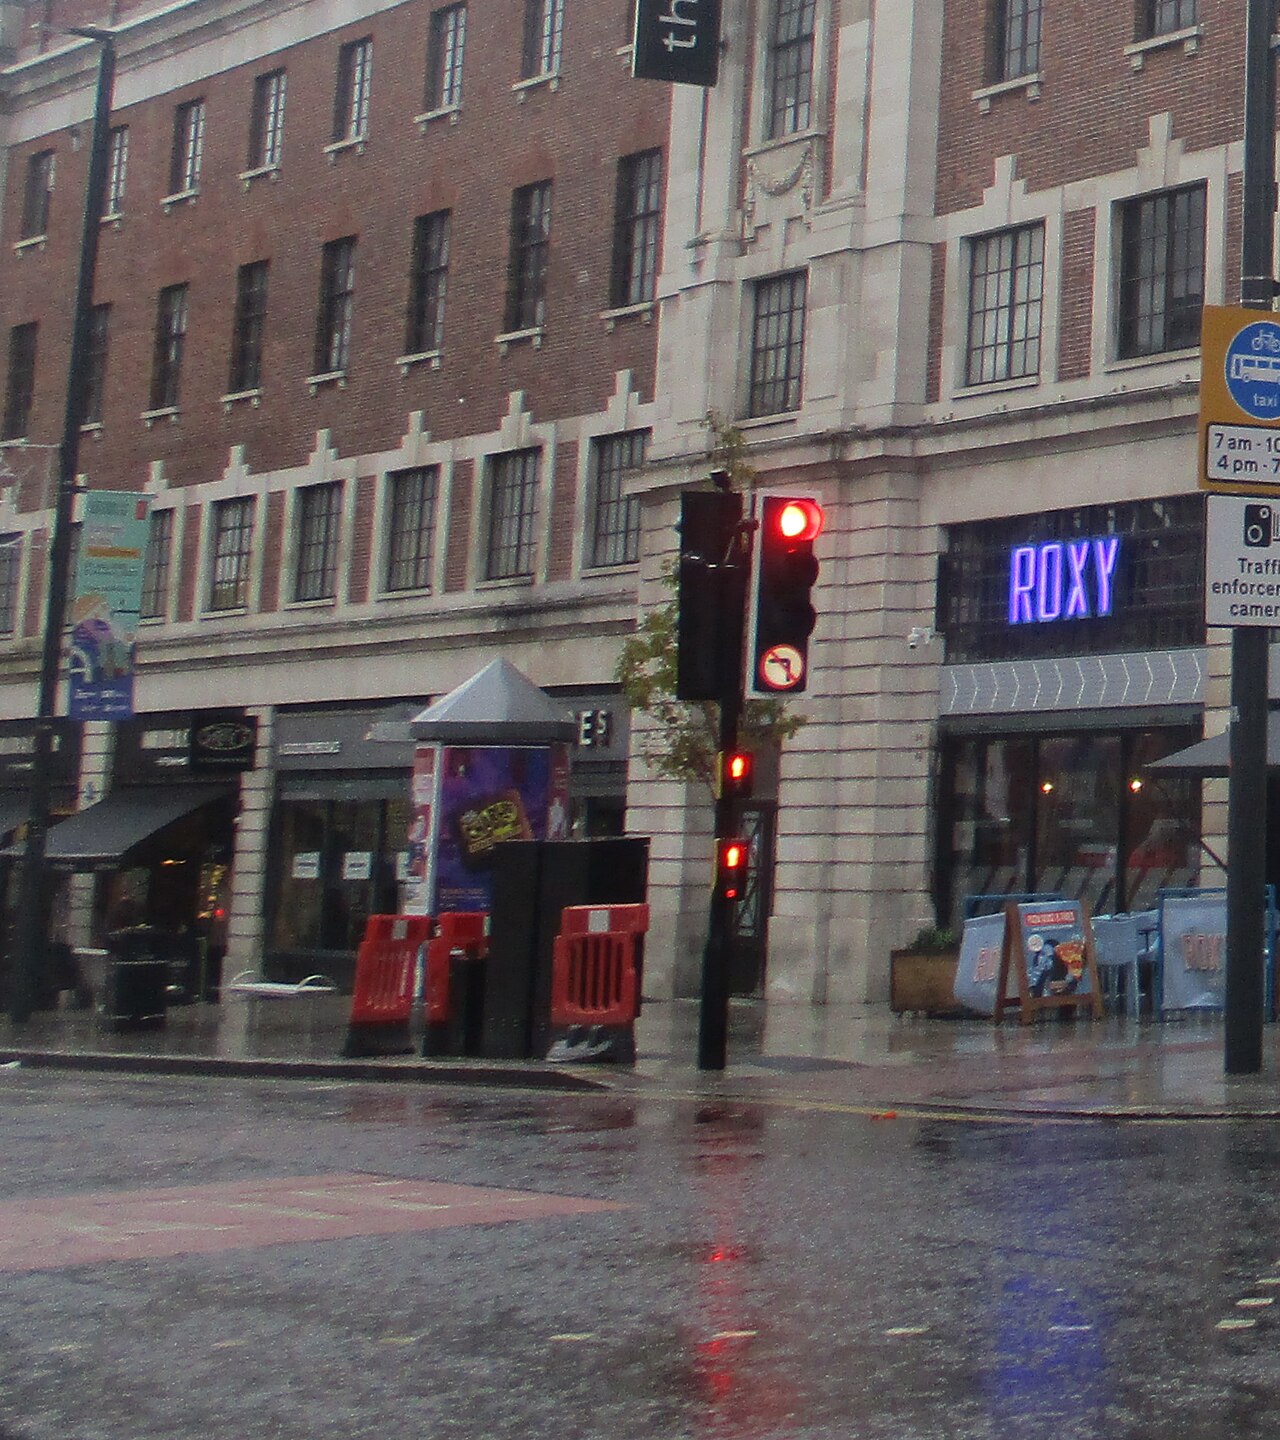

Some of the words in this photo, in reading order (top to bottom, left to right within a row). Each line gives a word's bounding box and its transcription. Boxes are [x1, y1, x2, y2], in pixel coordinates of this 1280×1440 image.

[1253, 393, 1278, 408] taxi
[1214, 433, 1224, 449] 7
[1228, 437, 1252, 451] am
[1217, 454, 1228, 470] 4
[1233, 458, 1258, 473] pm
[1271, 458, 1280, 474] 7
[1008, 536, 1121, 625] ROXY
